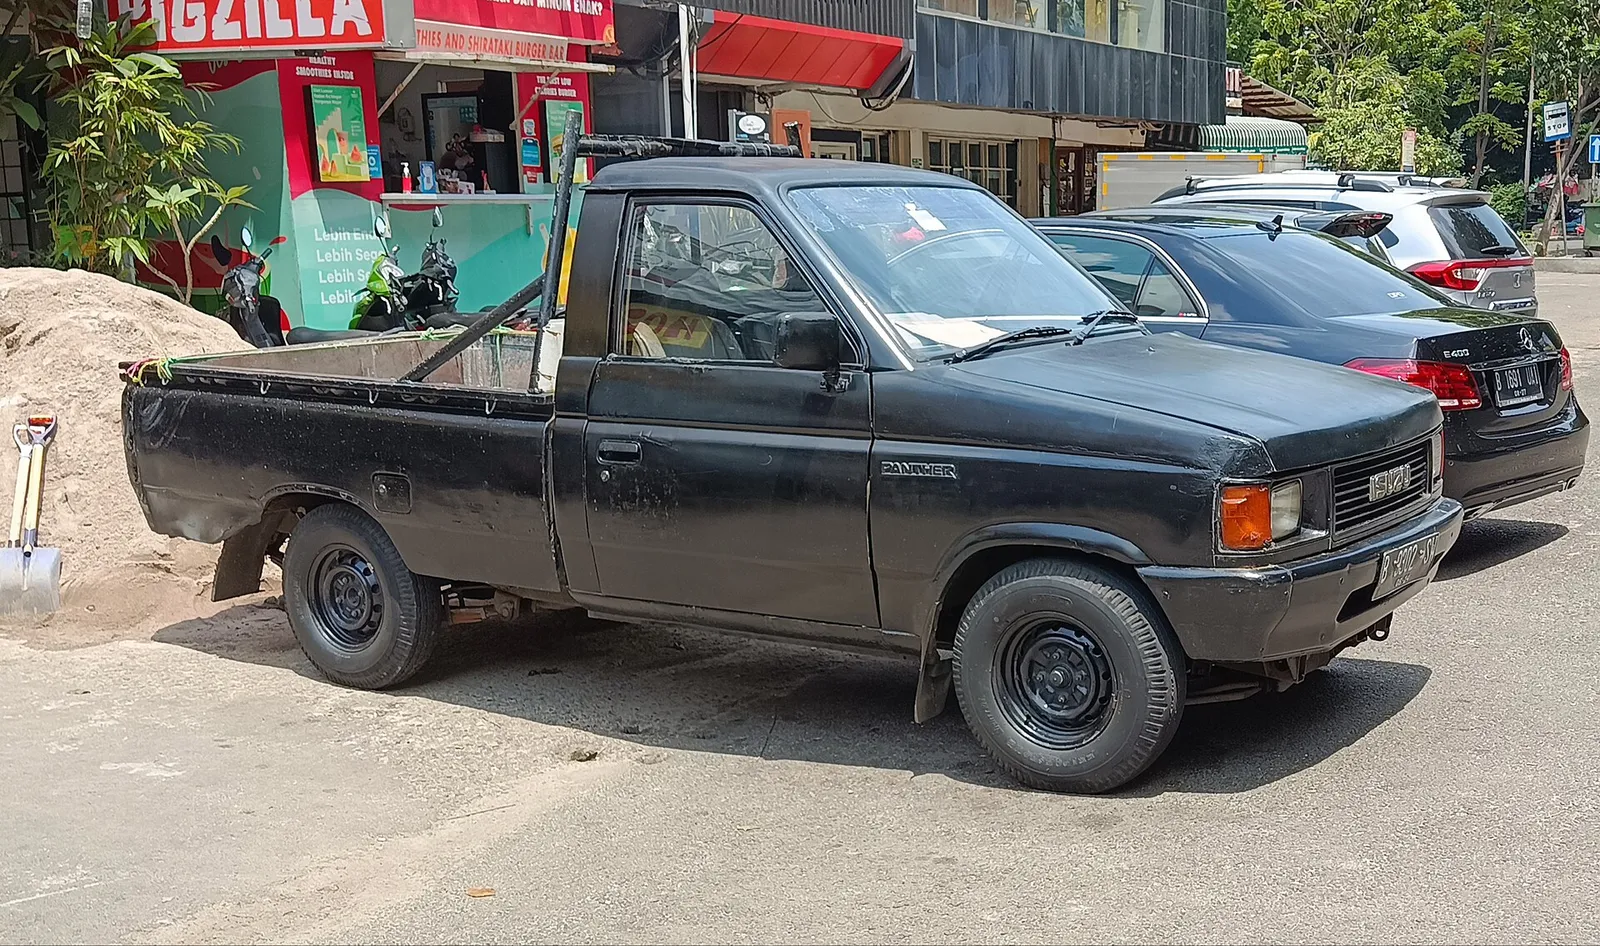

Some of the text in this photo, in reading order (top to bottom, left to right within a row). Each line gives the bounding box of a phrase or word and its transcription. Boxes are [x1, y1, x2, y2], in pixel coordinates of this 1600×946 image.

[574, 1, 603, 16] ENAK?
[445, 32, 464, 50] AND
[468, 35, 513, 56] SHIRATAKI
[515, 41, 546, 59] BURGER
[549, 46, 564, 60] BAR
[296, 66, 332, 78] SMOOTHIES
[1547, 122, 1567, 132] STOP
[314, 226, 351, 242] Lebih
[316, 247, 353, 263] Lebih
[318, 268, 355, 284] Lebih
[320, 289, 357, 305] Lebih
[1443, 348, 1470, 359] E400
[1494, 371, 1502, 391] B
[1504, 368, 1523, 390] 1691
[881, 461, 957, 479] PANTHER
[1369, 462, 1411, 502] ISUZU
[1380, 554, 1391, 584] B
